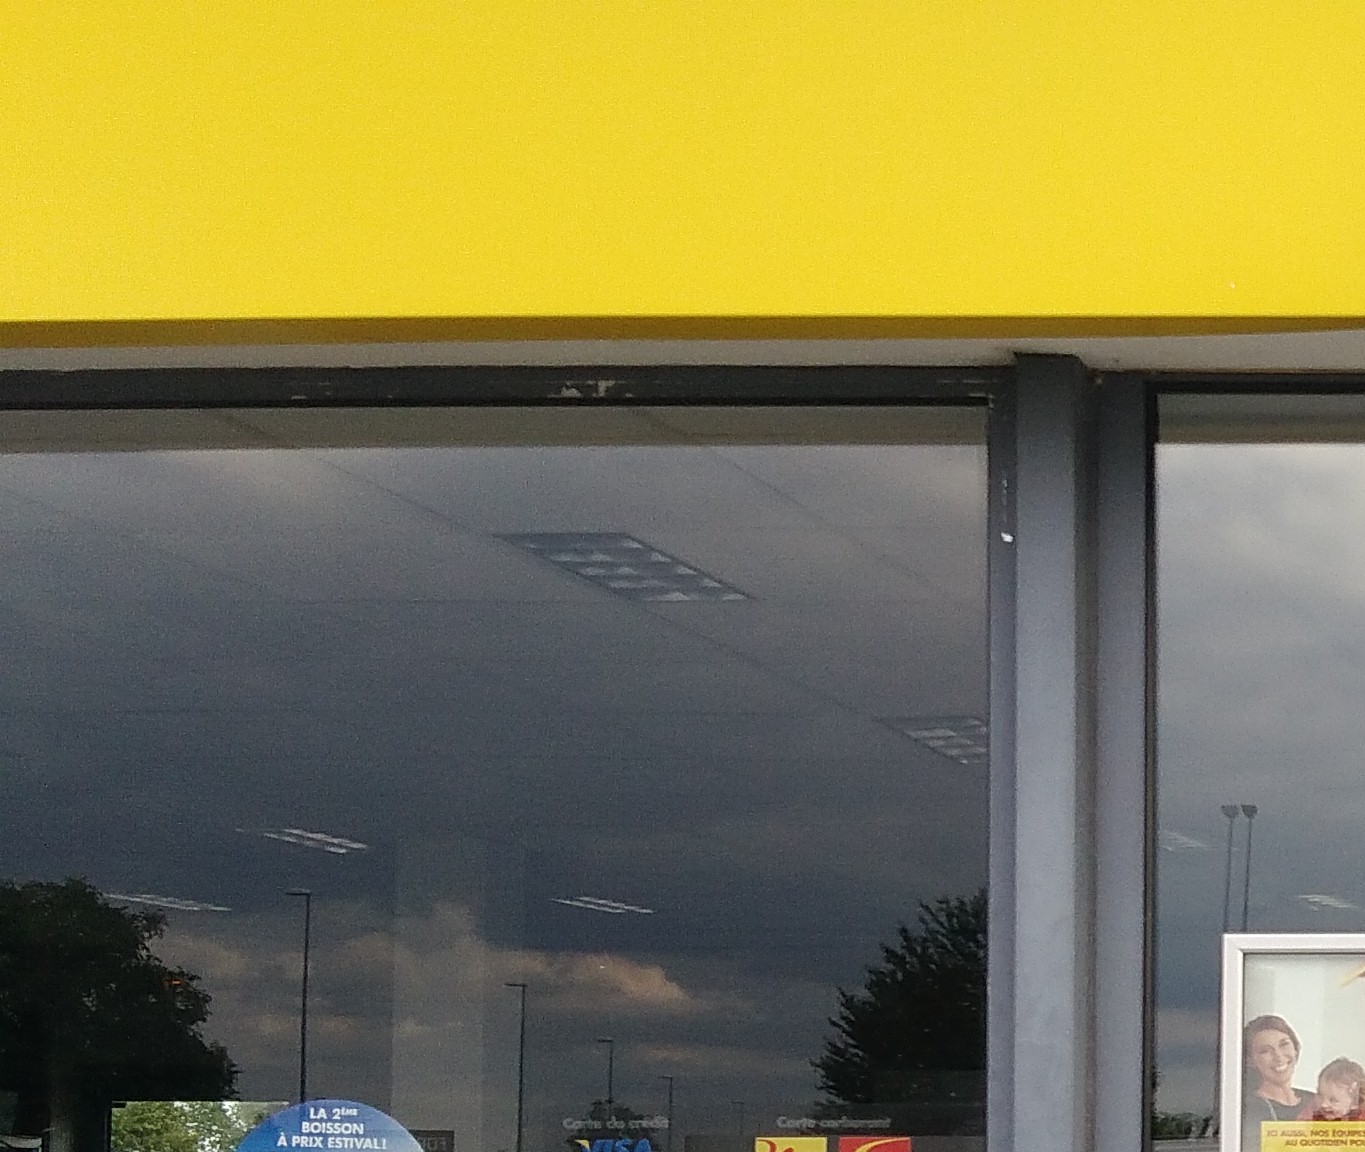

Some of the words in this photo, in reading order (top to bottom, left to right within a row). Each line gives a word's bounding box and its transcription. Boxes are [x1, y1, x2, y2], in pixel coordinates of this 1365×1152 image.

[309, 1107, 326, 1120] LA
[301, 1121, 364, 1135] BOISSON
[1310, 1130, 1329, 1138] NOS
[276, 1131, 288, 1148] À
[291, 1136, 323, 1148] PRIX
[1285, 1139, 1297, 1147] AU
[1299, 1139, 1348, 1147] QUOTIDIEN
